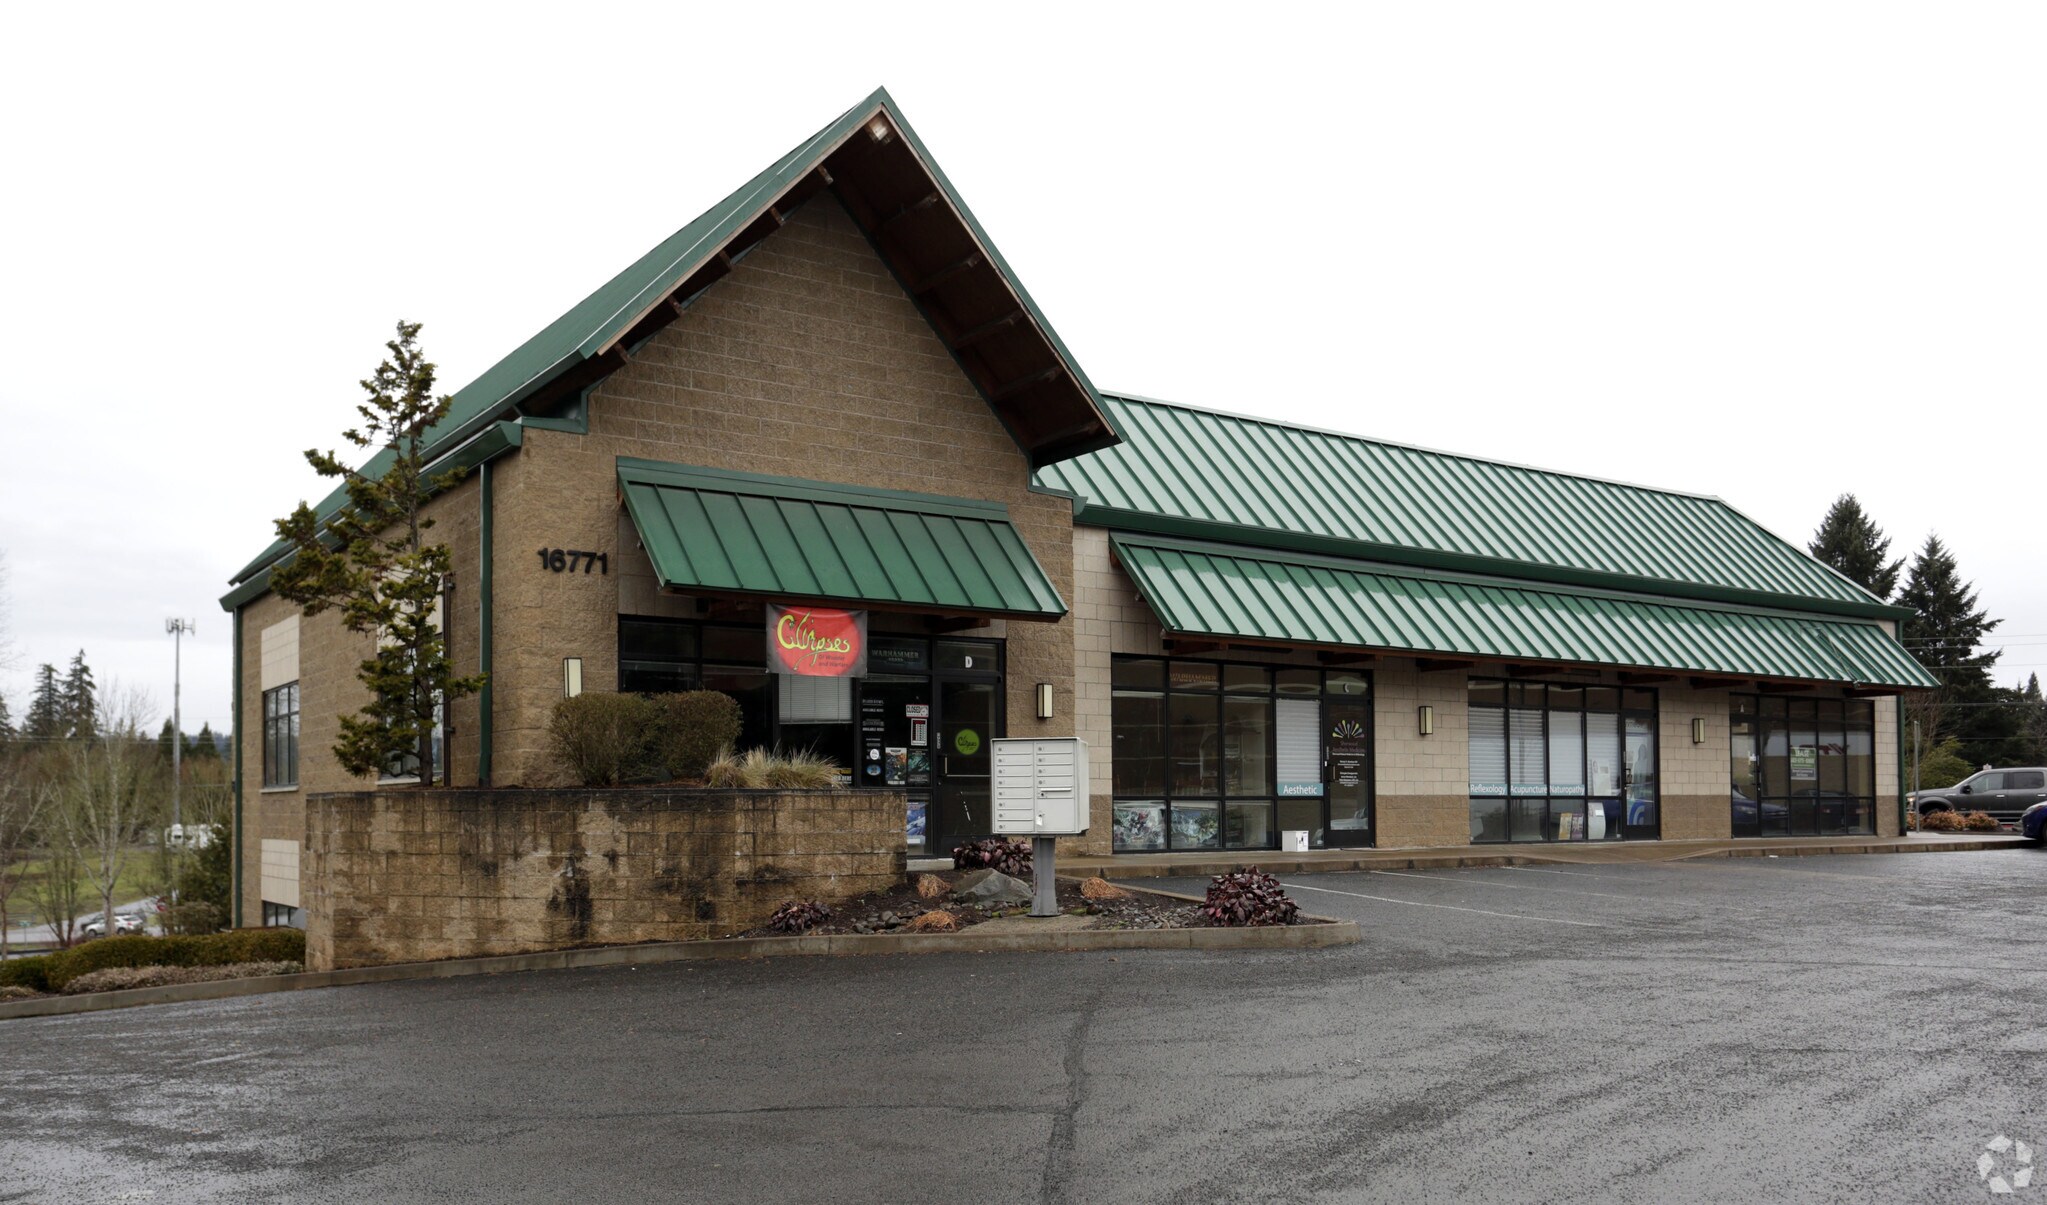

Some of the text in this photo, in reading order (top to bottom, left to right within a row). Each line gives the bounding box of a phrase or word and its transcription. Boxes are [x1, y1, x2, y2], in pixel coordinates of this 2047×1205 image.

[537, 547, 607, 575] 16771
[871, 649, 919, 658] WARHAMMER
[965, 656, 973, 668] D
[1283, 784, 1317, 794] Aesthetic
[1470, 784, 1506, 794] Reflexology
[1511, 784, 1547, 795] Acupuncture
[1549, 785, 1585, 795] Naturopathy
